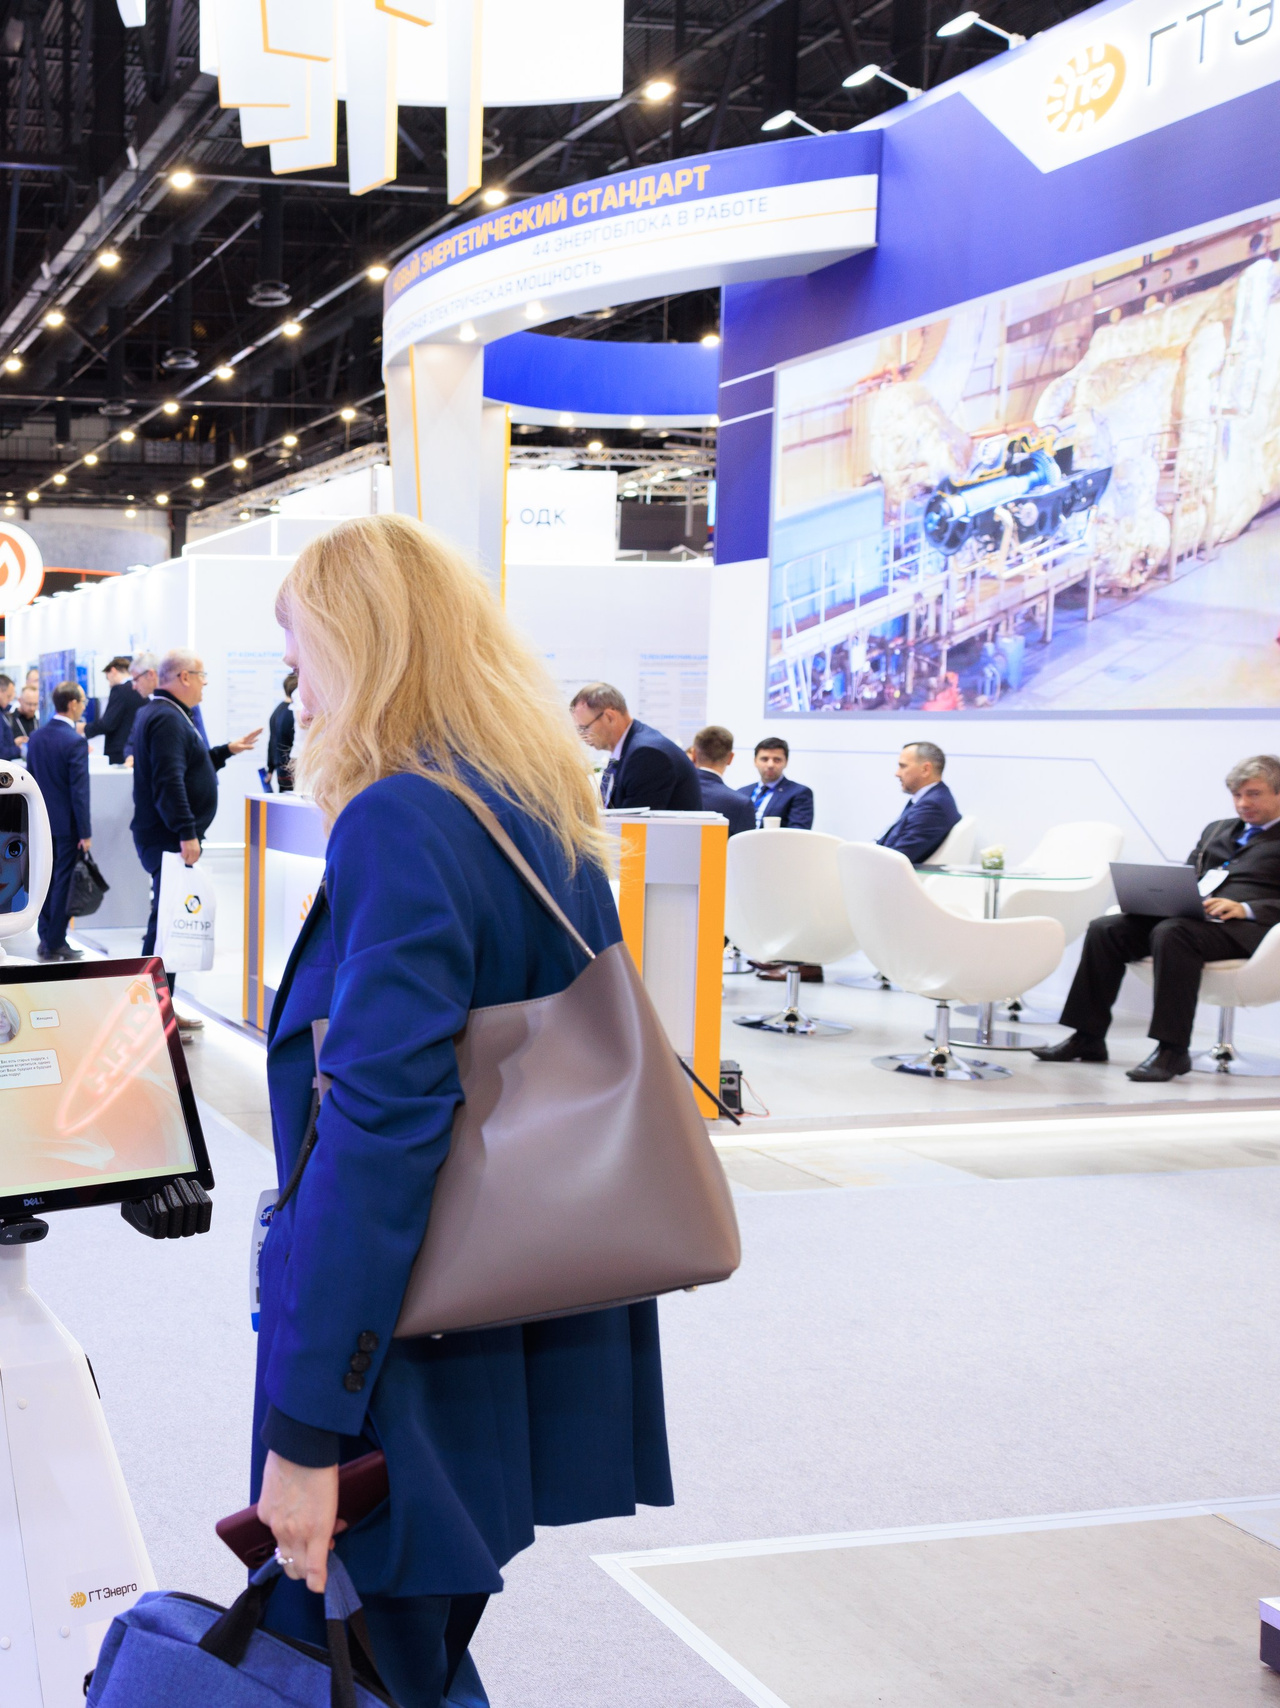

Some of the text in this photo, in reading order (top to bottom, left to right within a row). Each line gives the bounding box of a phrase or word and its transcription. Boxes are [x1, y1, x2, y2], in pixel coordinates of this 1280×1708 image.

[420, 193, 568, 274] ЭНЕРГЕТИЧЕСКИЙ
[571, 164, 711, 218] СТАНДАРТ
[554, 213, 671, 252] ЭНЕРГОБЛОКА
[677, 210, 689, 227] В
[694, 196, 769, 221] РАБОТЕ
[516, 261, 602, 292] МОЩНОСТЬ
[520, 508, 567, 526] ОДК
[23, 1197, 45, 1207] DELL
